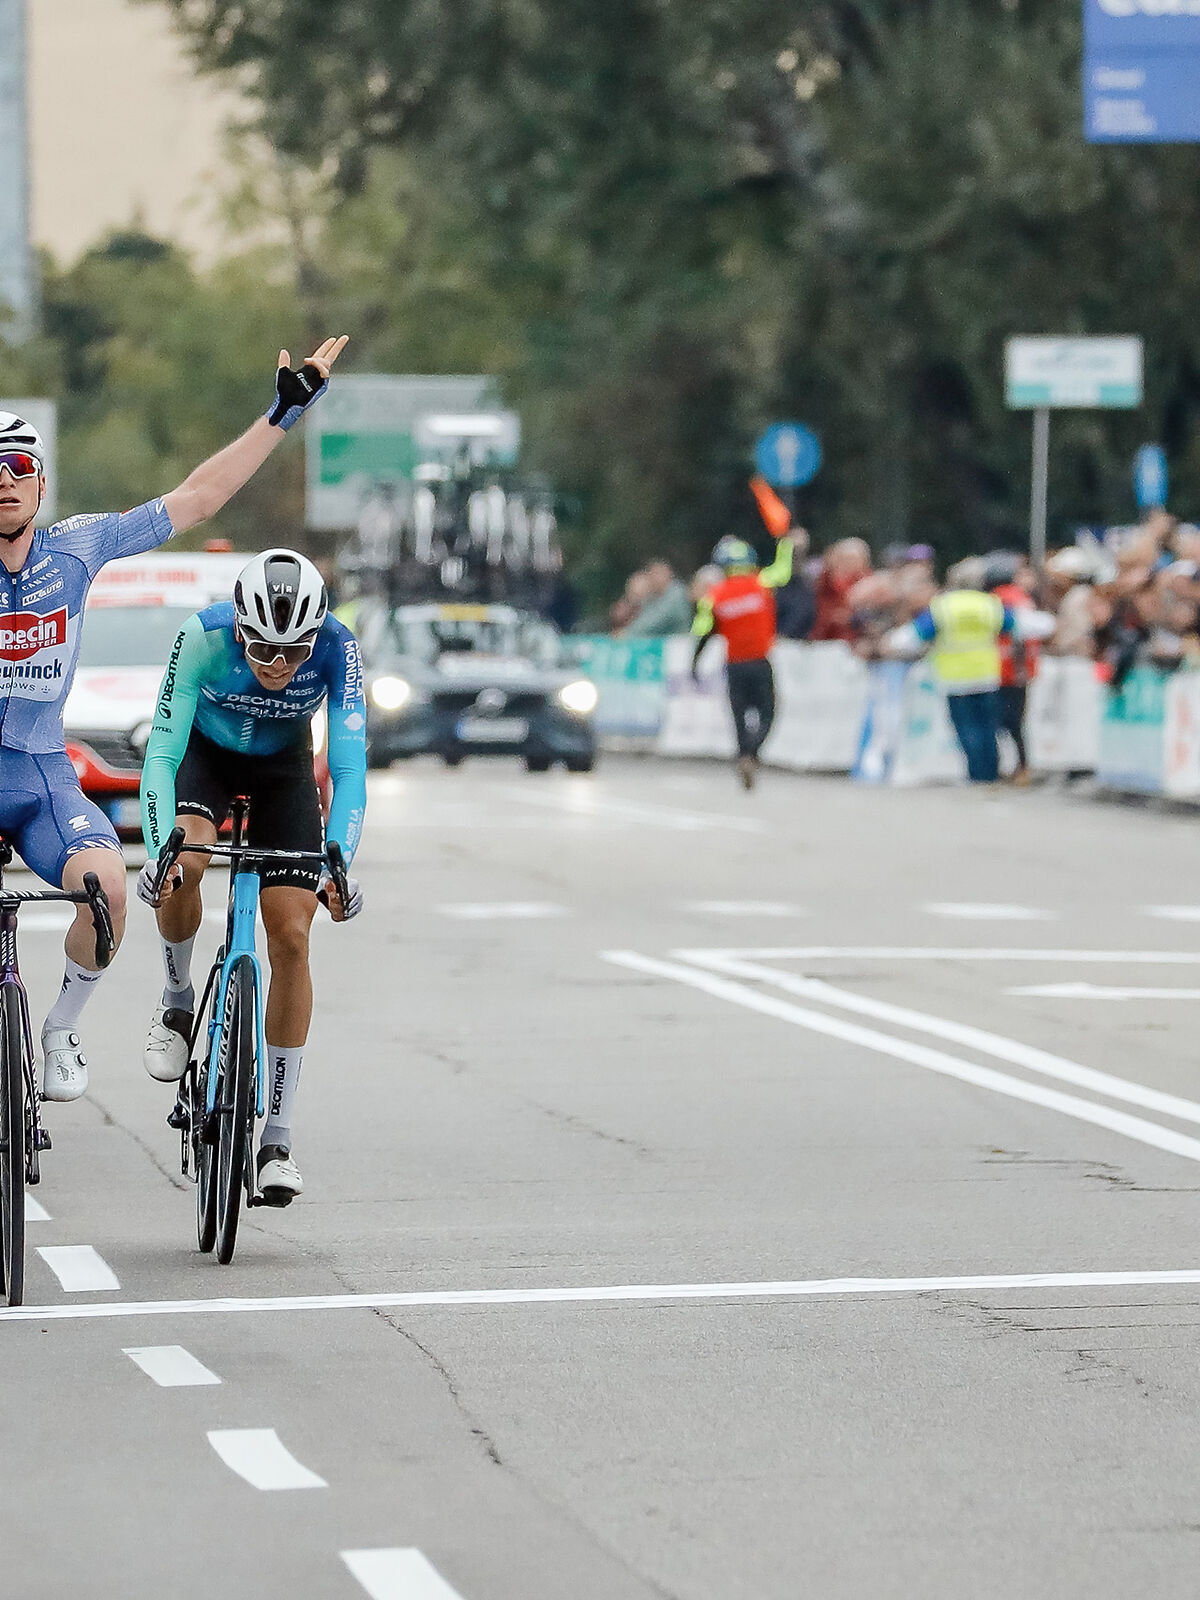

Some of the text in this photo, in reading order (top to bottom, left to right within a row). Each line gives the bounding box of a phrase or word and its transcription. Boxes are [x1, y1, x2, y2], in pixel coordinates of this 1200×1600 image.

[6, 638, 57, 650] BOOSTER
[161, 630, 186, 702] DECATHLON
[342, 640, 358, 711] MONDIALE
[265, 868, 287, 877] VAN
[271, 1056, 286, 1116] DECATHLON
